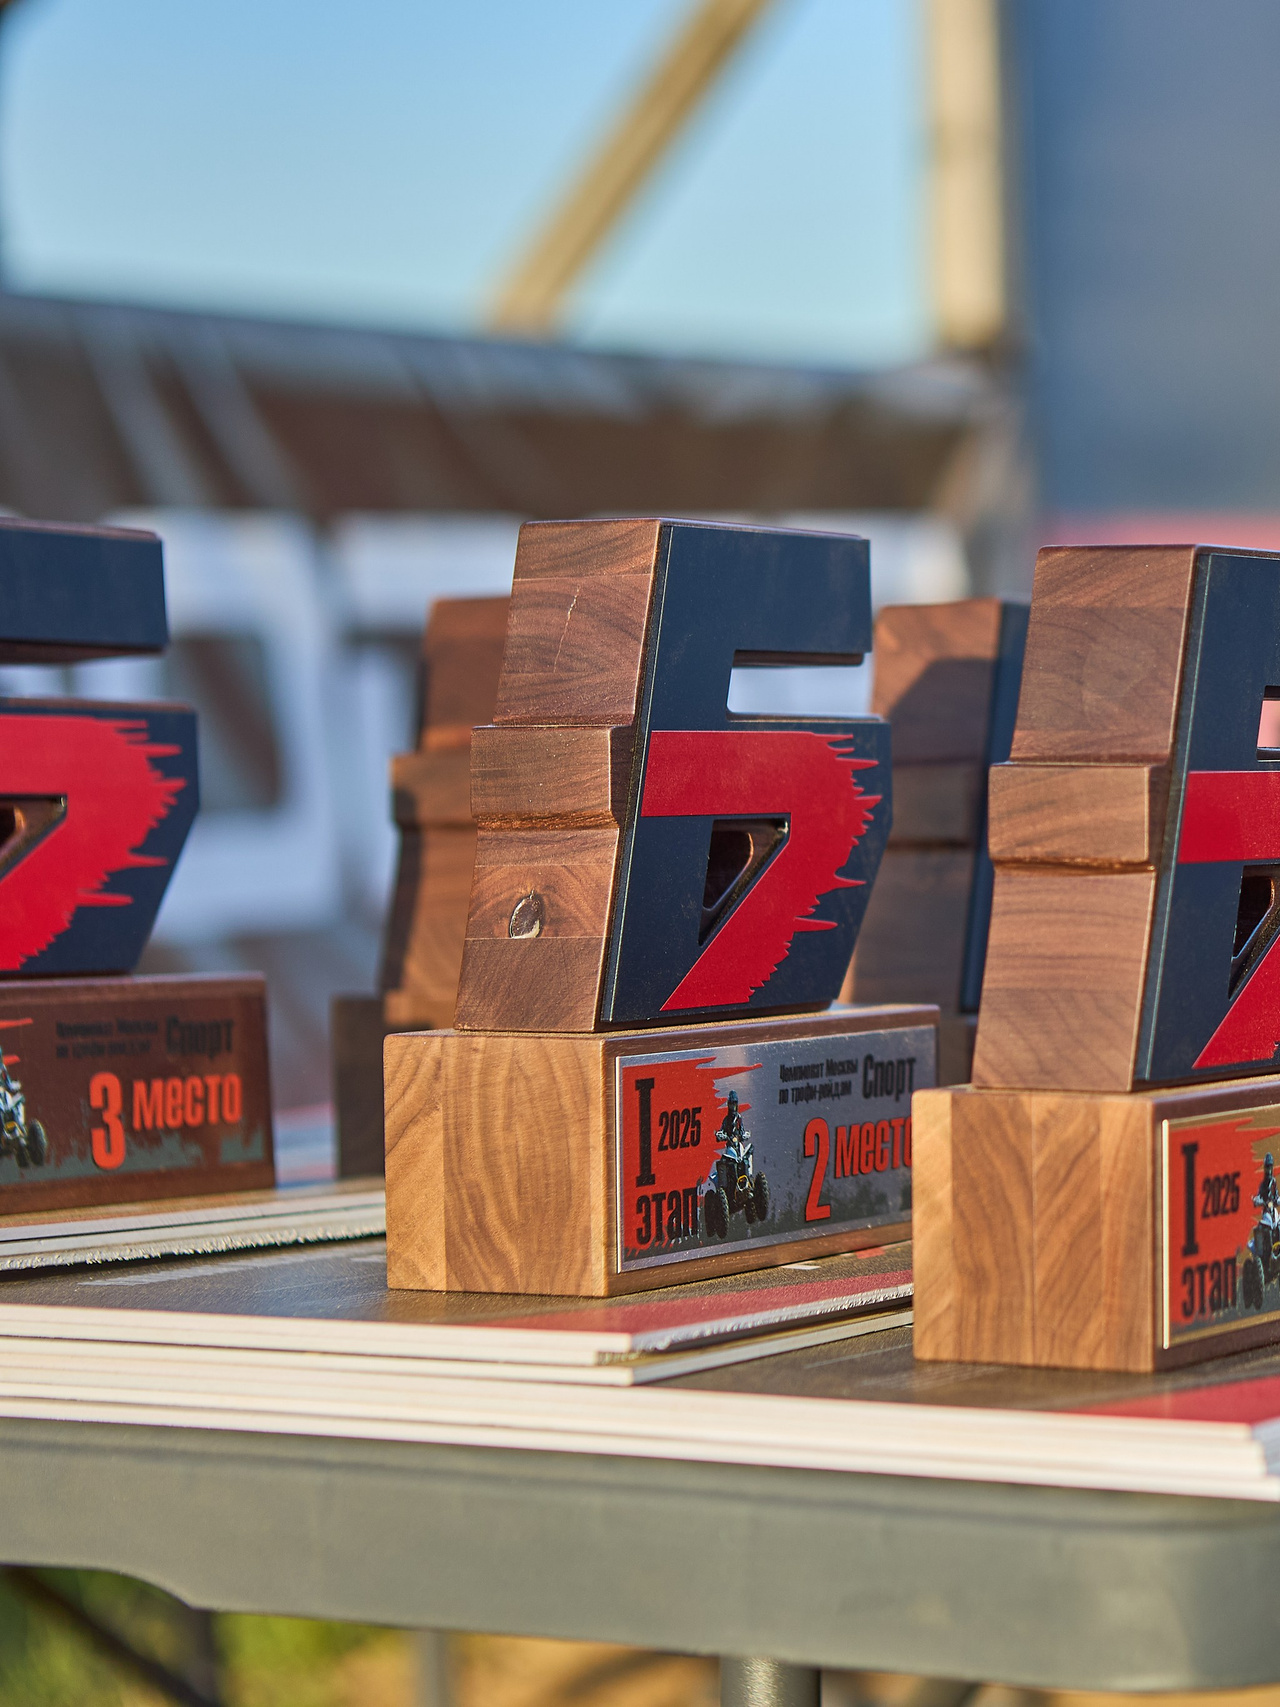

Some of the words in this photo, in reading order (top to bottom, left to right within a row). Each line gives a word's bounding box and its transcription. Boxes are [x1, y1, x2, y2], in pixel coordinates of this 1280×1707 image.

[862, 1053, 916, 1103] Спорт
[89, 1071, 126, 1170] 3
[657, 1107, 702, 1152] 2025
[803, 1117, 832, 1223] 2
[1202, 1171, 1241, 1220] 2025
